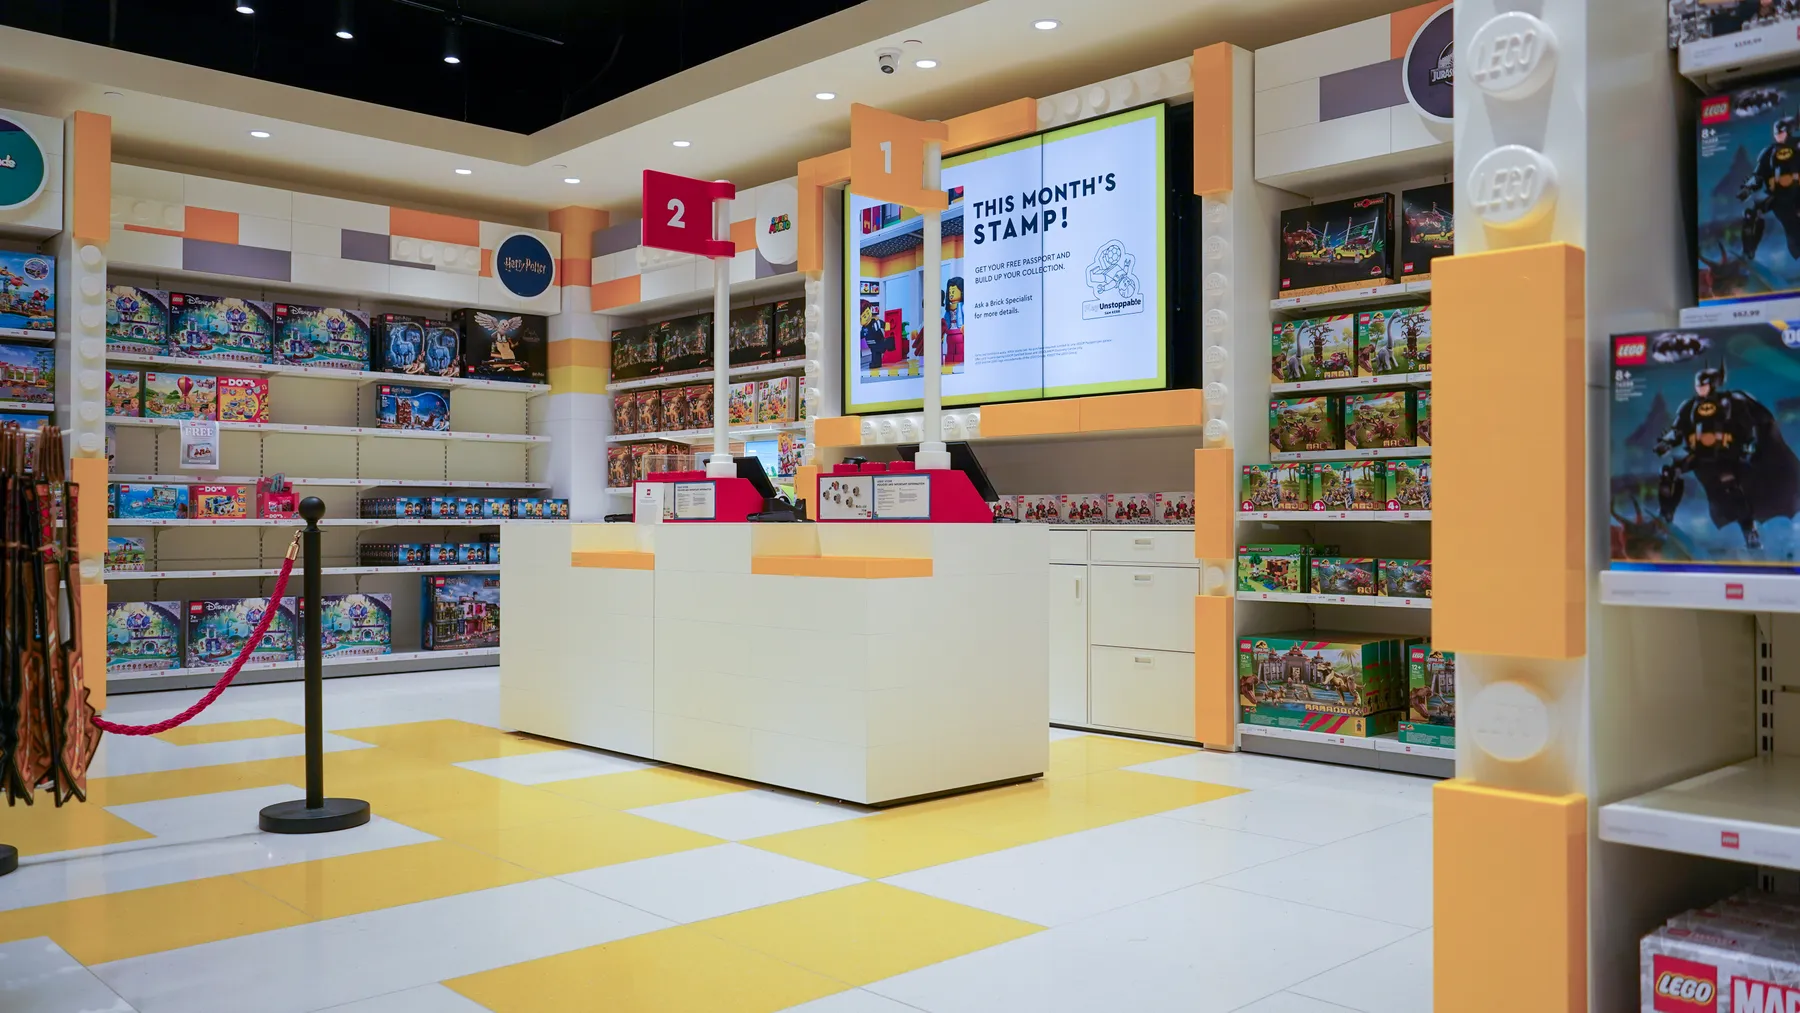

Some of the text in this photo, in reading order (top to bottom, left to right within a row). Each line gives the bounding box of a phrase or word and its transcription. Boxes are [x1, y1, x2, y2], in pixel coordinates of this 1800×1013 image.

[1474, 28, 1536, 83] LEGO
[1430, 68, 1453, 82] JURAS
[1703, 103, 1728, 118] LEGO
[1701, 128, 1716, 138] 8+
[880, 140, 892, 174] 1
[973, 172, 1116, 219] THIS MONTH'S
[1474, 164, 1536, 214] LEGO
[667, 198, 685, 229] 2
[771, 213, 789, 225] SUPER
[768, 219, 791, 234] MARIO
[973, 206, 1068, 245] STAMP!
[504, 256, 546, 274] Harry Potter
[974, 251, 1071, 274] GET YOUR FREE PASSPORT AND
[974, 263, 1066, 284] BUILD UP YOUR COLLECTION.
[185, 294, 216, 307] Disney
[974, 301, 985, 309] Ask
[990, 298, 1004, 307] Brick
[1005, 294, 1033, 305] Specialist
[1099, 298, 1142, 310] Unstoppable
[289, 305, 316, 317] Disney
[983, 310, 998, 318] more
[998, 307, 1020, 316] details.
[1617, 342, 1645, 358] LEGO
[1615, 369, 1632, 381] 8+
[184, 427, 214, 437] FREE
[1388, 501, 1399, 509] 4+
[204, 601, 235, 611] Disney
[1657, 973, 1714, 1004] LEGO
